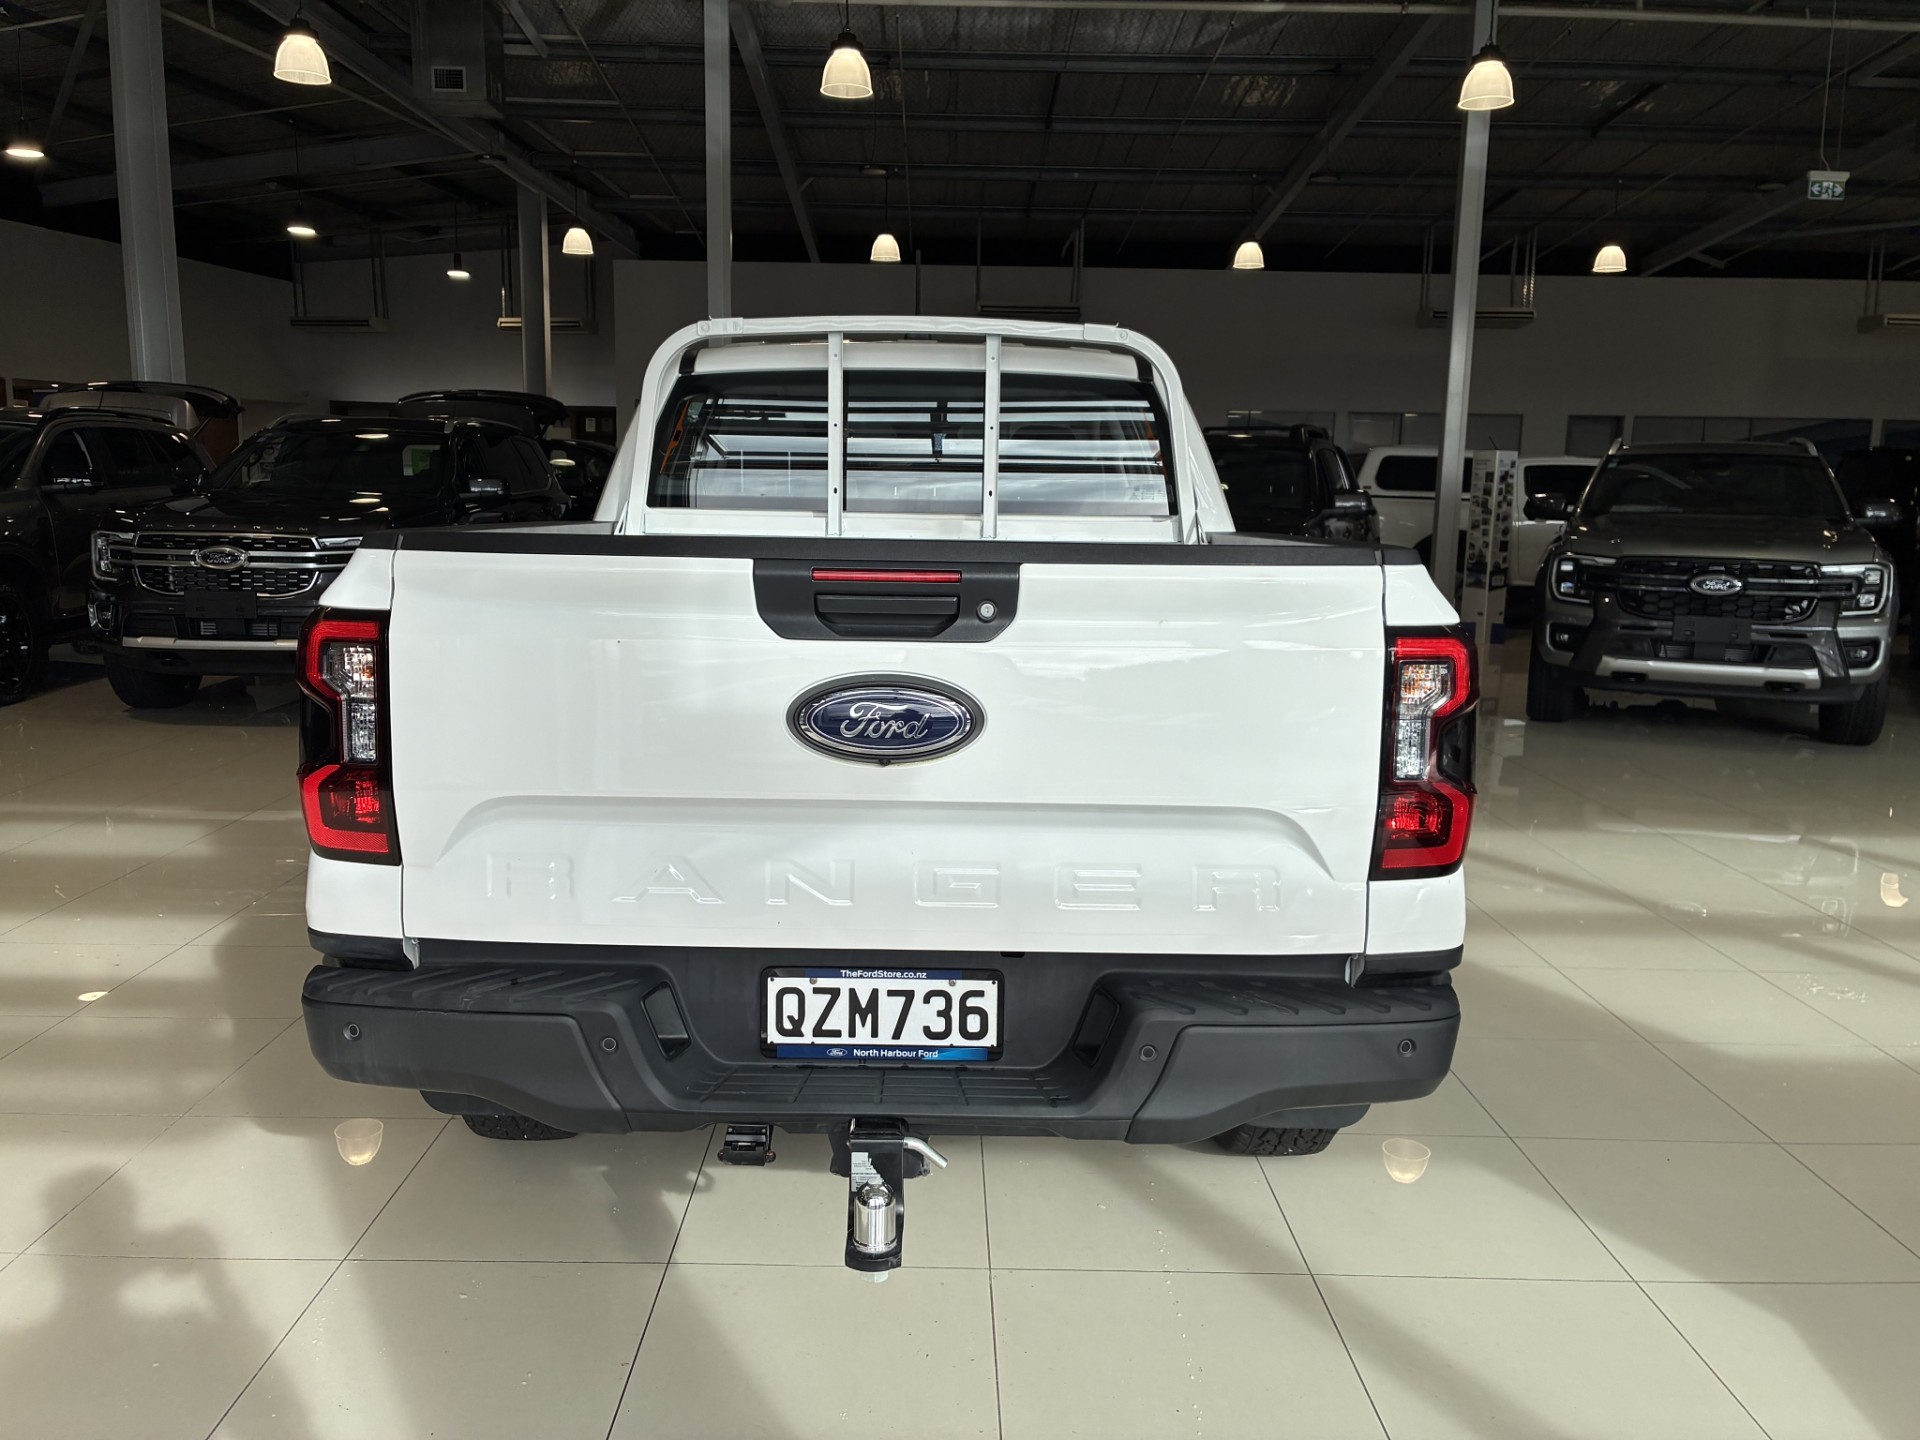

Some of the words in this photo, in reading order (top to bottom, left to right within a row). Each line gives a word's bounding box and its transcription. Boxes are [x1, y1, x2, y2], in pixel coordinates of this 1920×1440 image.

[207, 553, 231, 564] Ford
[840, 702, 932, 738] Ford
[487, 853, 1281, 911] RANGER
[840, 969, 928, 979] TheFordStore.co.nz
[775, 986, 989, 1041] QZM736
[853, 1048, 880, 1057] North
[880, 1049, 917, 1058] Harbour
[918, 1049, 939, 1058] Ford
